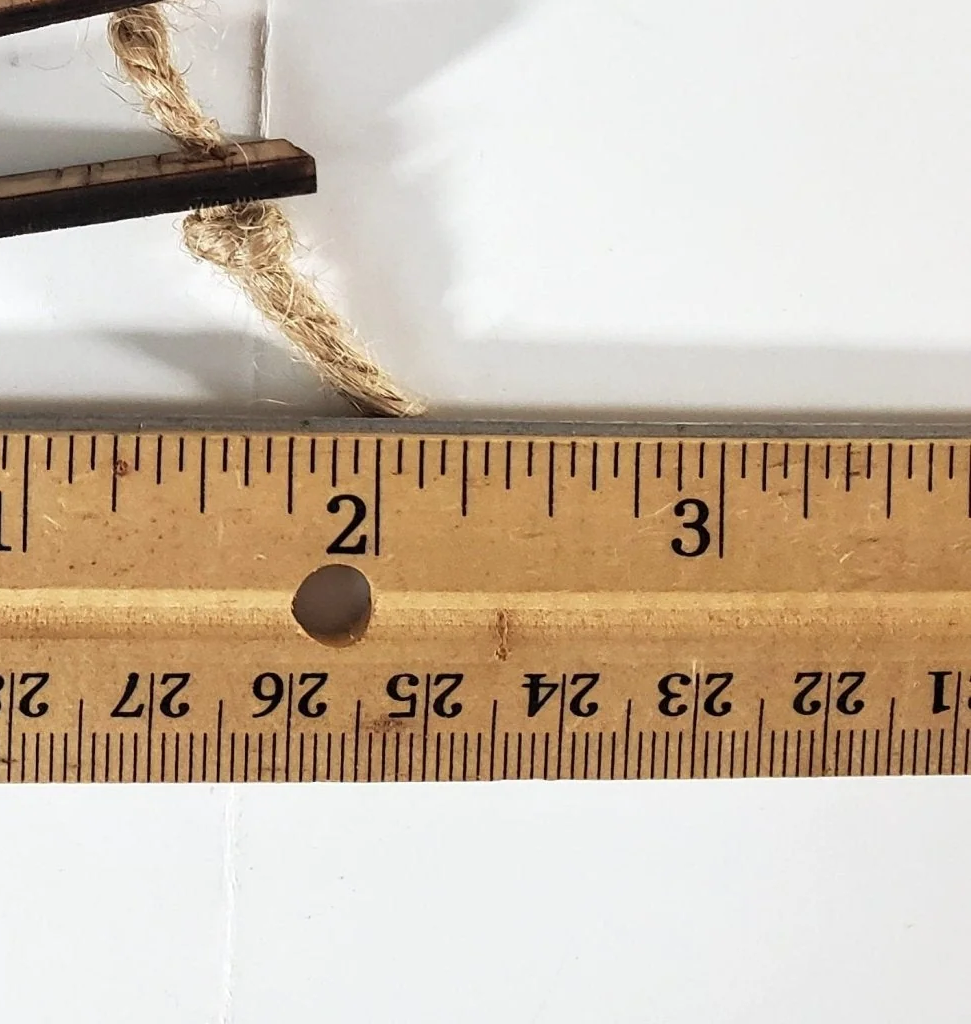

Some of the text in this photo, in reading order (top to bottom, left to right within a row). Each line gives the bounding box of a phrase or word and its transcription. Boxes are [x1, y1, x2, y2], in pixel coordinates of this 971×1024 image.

[326, 494, 367, 555] 2
[671, 498, 711, 557] 3
[110, 671, 191, 718] 27
[252, 671, 328, 718] 26
[386, 672, 464, 718] 25
[521, 672, 600, 718] 24
[657, 672, 733, 718] 23
[793, 671, 865, 715] 22
[928, 670, 971, 714] 1
